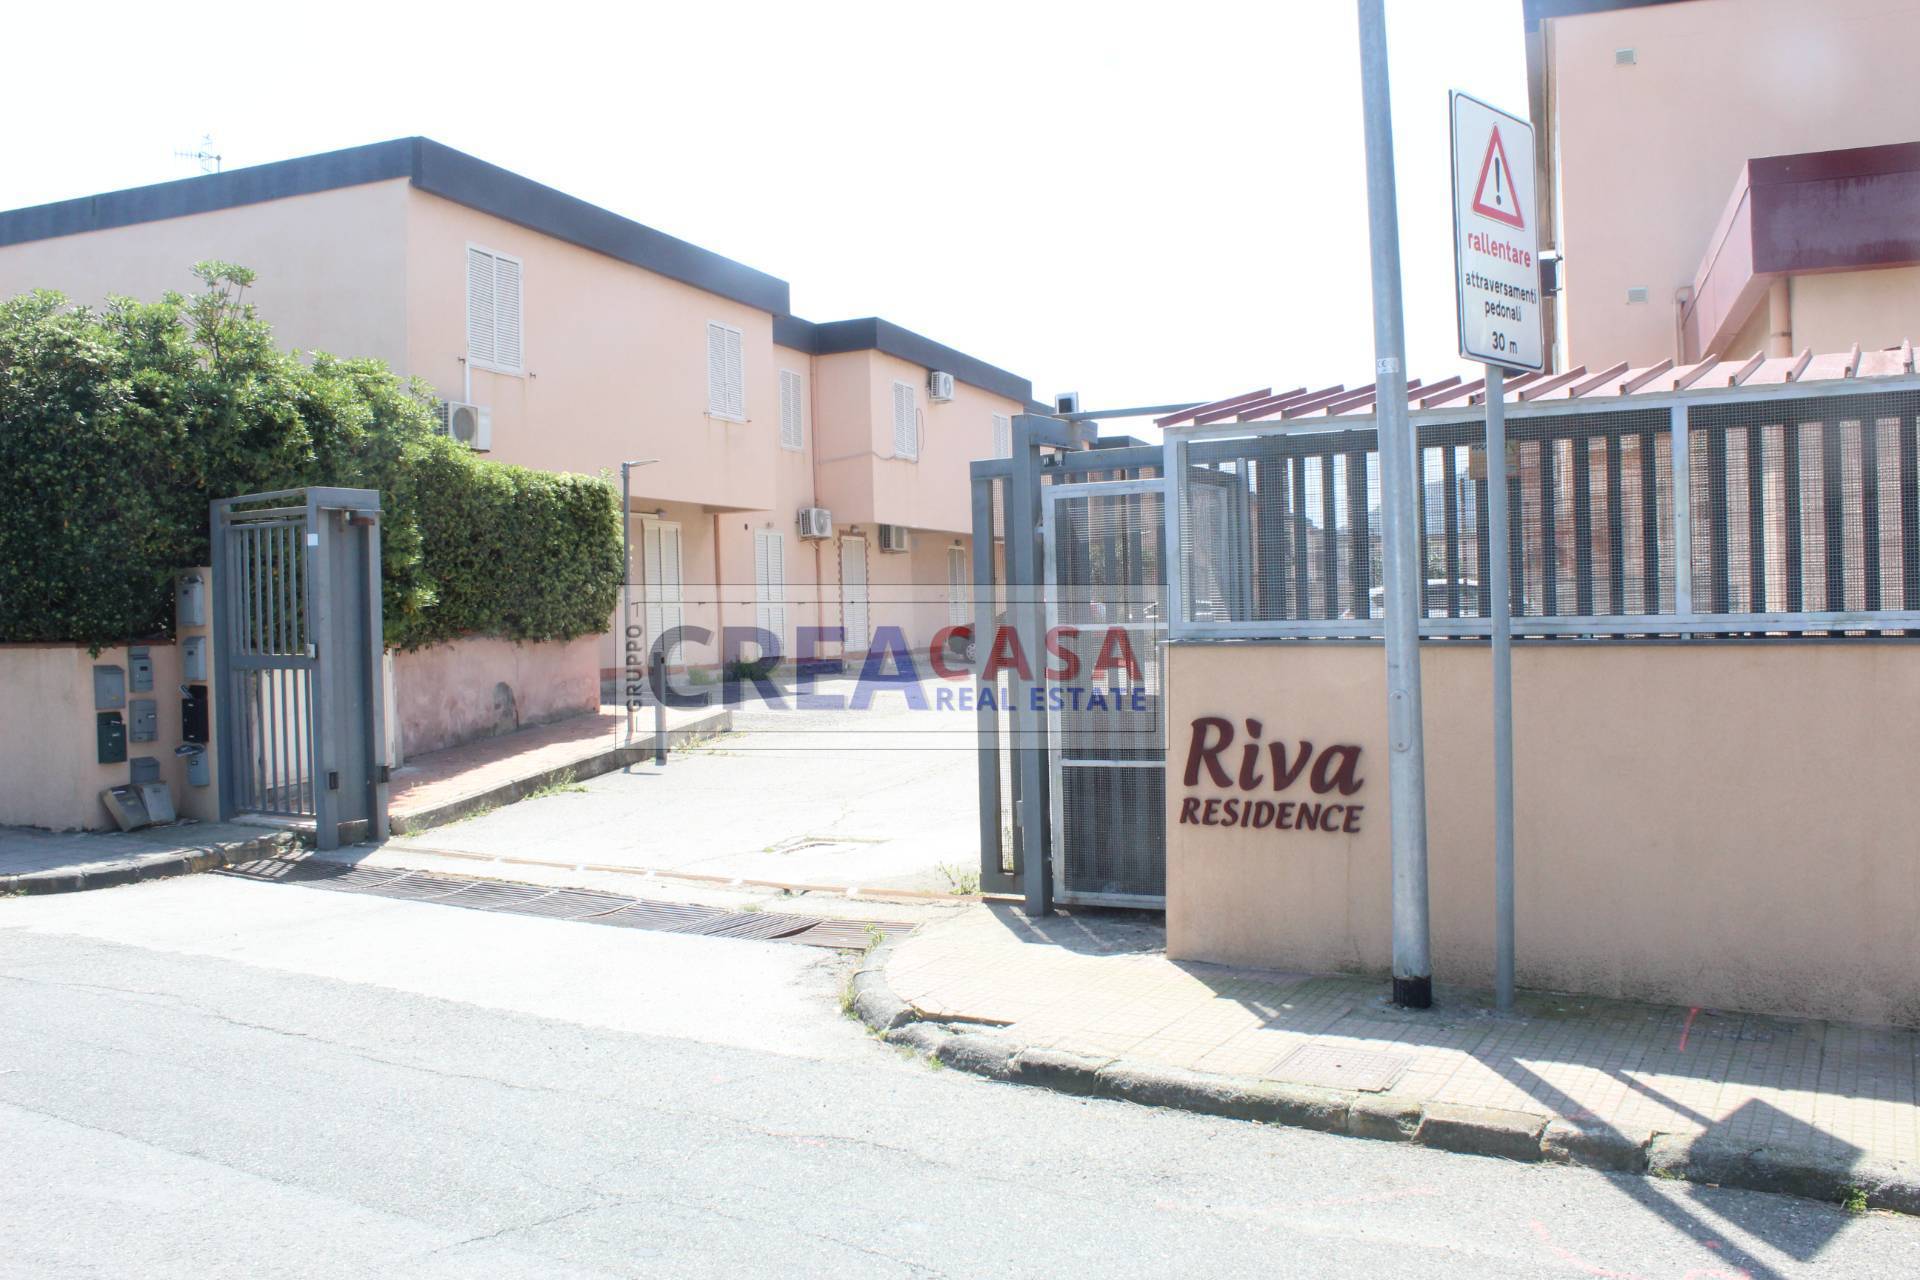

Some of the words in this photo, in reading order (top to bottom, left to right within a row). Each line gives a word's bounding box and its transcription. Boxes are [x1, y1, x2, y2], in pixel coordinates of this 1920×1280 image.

[1468, 232, 1531, 267] rallentare
[1465, 271, 1537, 304] attraversamenti
[1485, 300, 1522, 322] pedonali
[1492, 331, 1505, 351] 30
[1509, 340, 1518, 354] m
[1184, 717, 1364, 796] Riva
[1179, 797, 1364, 833] RESIDENCE
